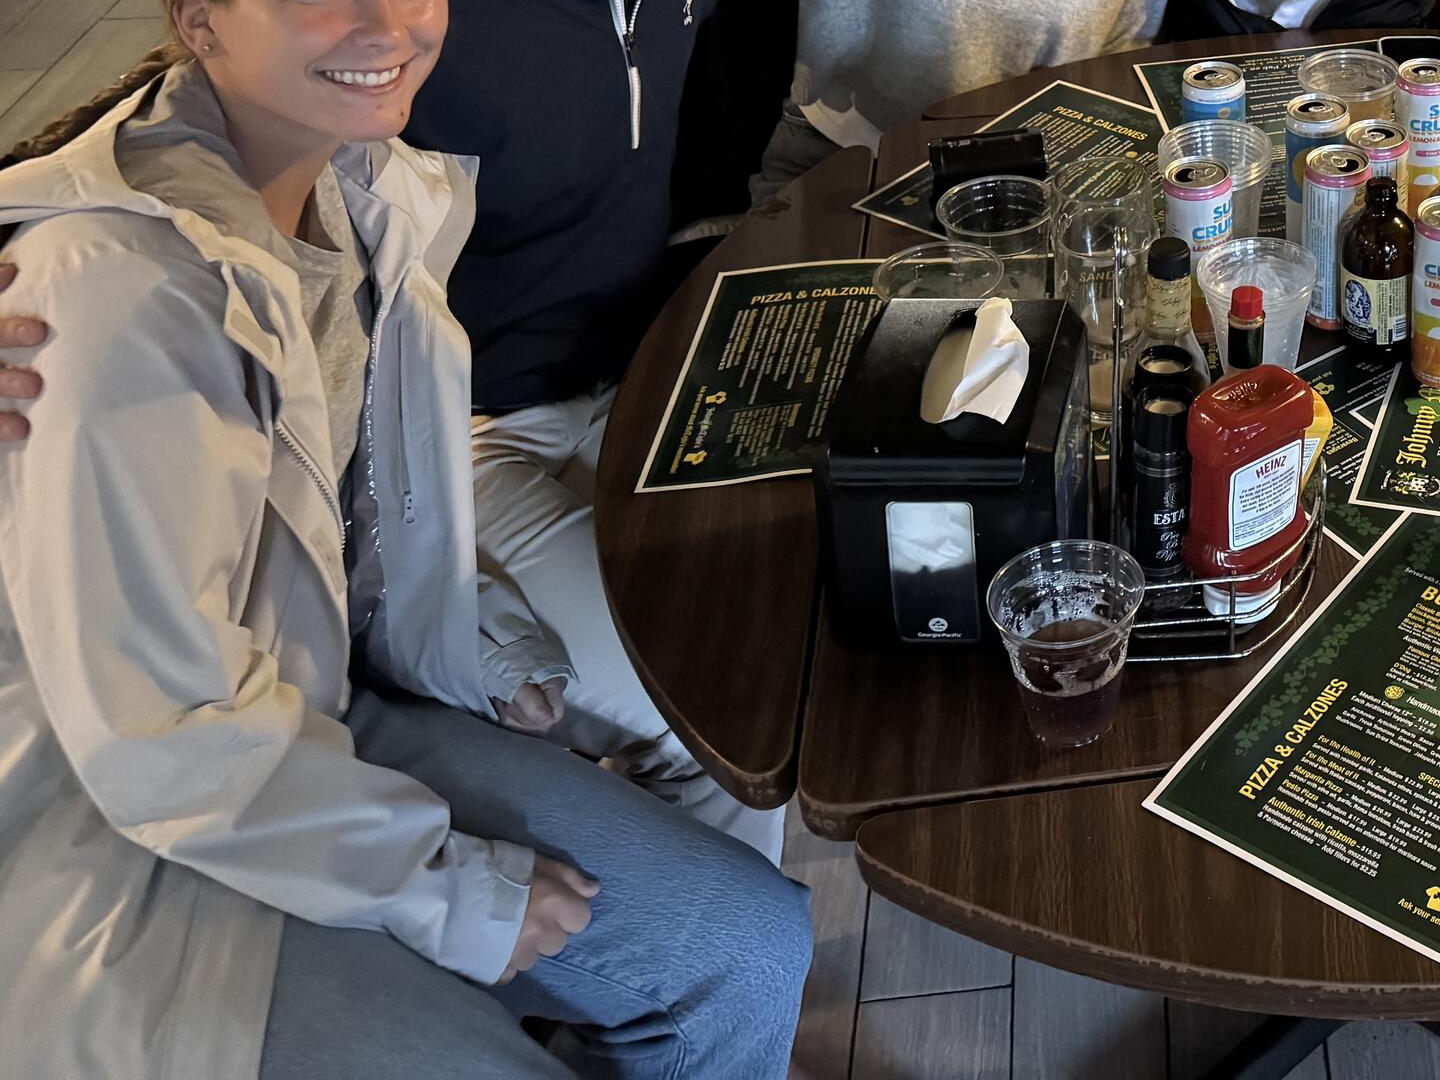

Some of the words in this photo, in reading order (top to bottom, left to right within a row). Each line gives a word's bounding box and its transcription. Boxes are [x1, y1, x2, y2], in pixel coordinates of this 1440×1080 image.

[1053, 105, 1083, 121] PIZZA
[1084, 115, 1094, 124] &
[1093, 119, 1148, 141] CALZONES
[750, 291, 793, 306] PIZZA
[796, 290, 808, 300] &
[1255, 456, 1287, 478] HEINZ
[1284, 678, 1348, 744] CALZONES
[1274, 744, 1295, 758] &
[1305, 750, 1317, 759] For
[1317, 756, 1328, 765] the
[1328, 761, 1345, 773] Meat
[1239, 757, 1284, 800] PIZZA
[1282, 779, 1301, 792] Pesto
[1300, 788, 1319, 801] Pizza
[1292, 765, 1325, 784] Margarita
[1324, 780, 1343, 793] Pizza
[1268, 797, 1305, 819] Authentic
[1306, 815, 1325, 830] Irish
[1325, 826, 1356, 846] Calzone
[1263, 804, 1292, 823] Handmade
[1292, 820, 1314, 834] calzone
[1314, 832, 1327, 841] with
[1327, 839, 1346, 852] ricotta,
[1347, 850, 1379, 868] mozzarella
[1398, 898, 1413, 910] Ask
[1412, 907, 1430, 919] your
